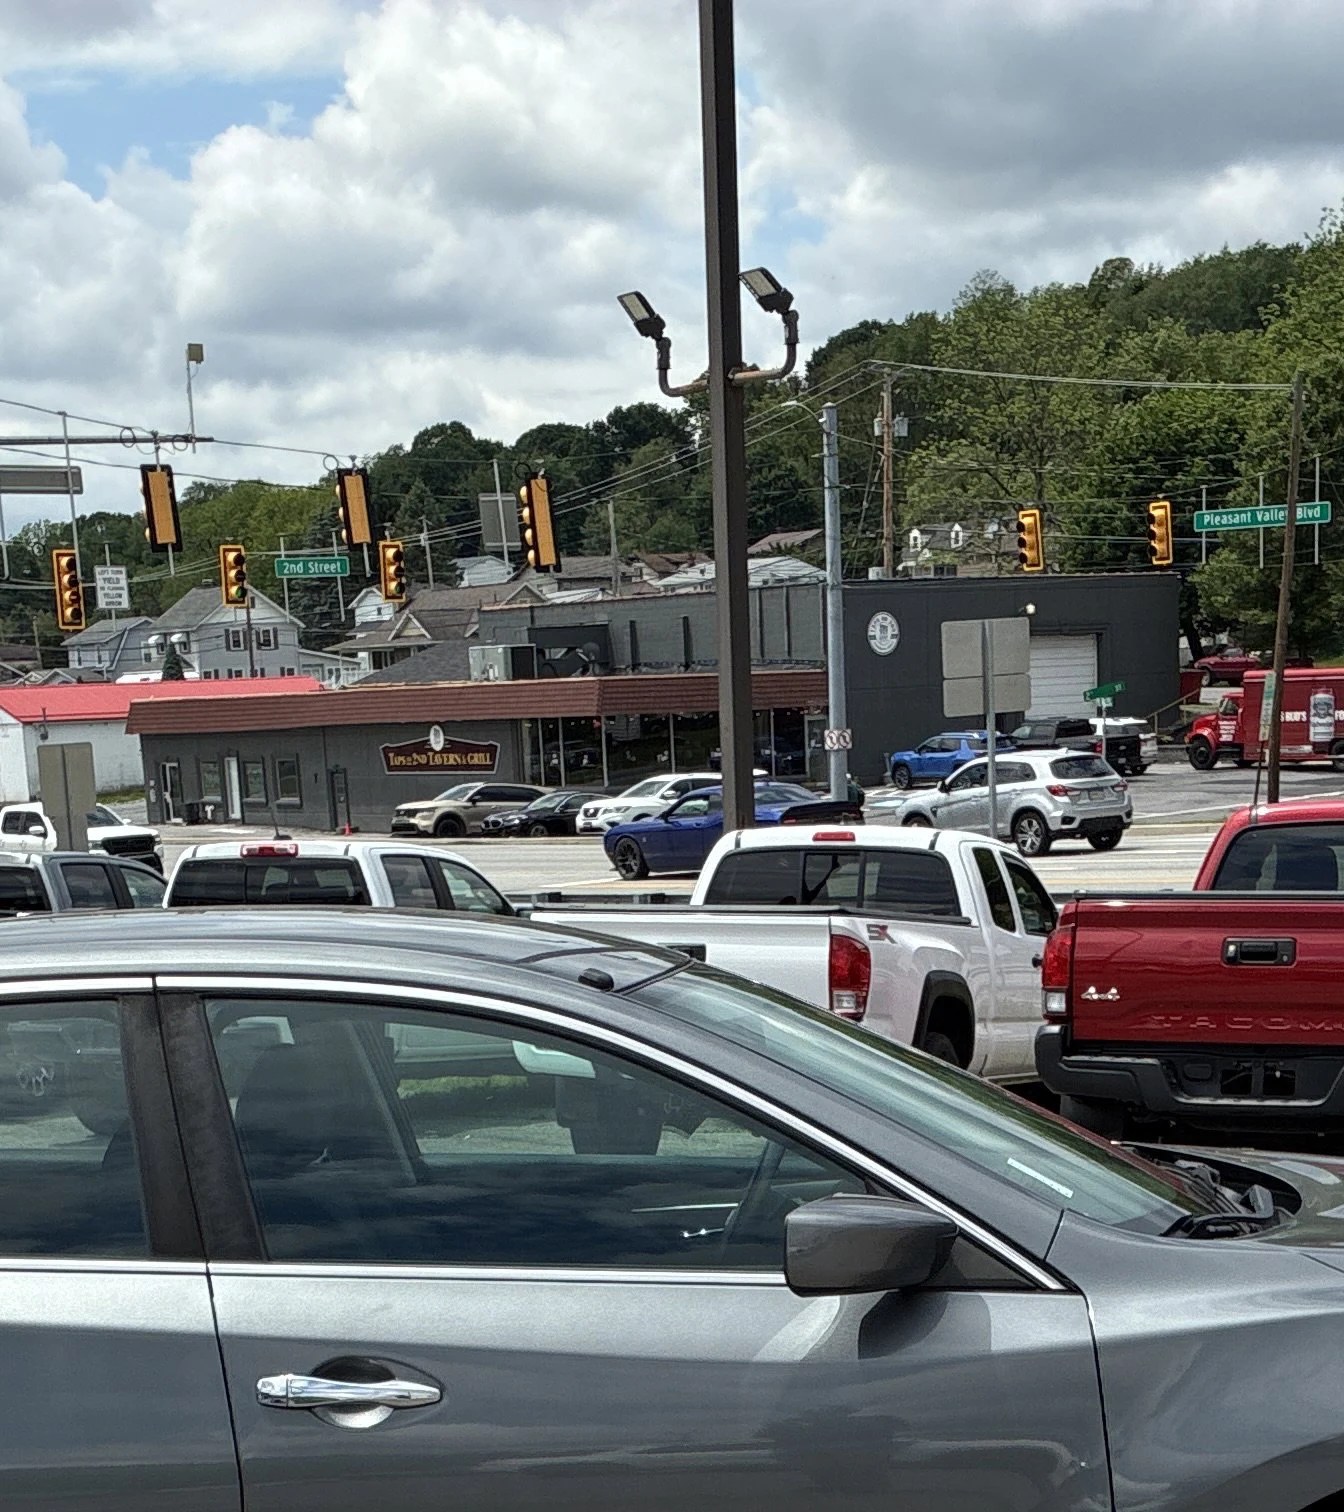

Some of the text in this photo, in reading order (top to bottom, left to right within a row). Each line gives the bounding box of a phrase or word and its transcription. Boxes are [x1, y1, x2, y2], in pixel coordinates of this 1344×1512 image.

[1203, 506, 1321, 526] Pleasant Valle Blvd
[283, 561, 342, 574] 2nd Street
